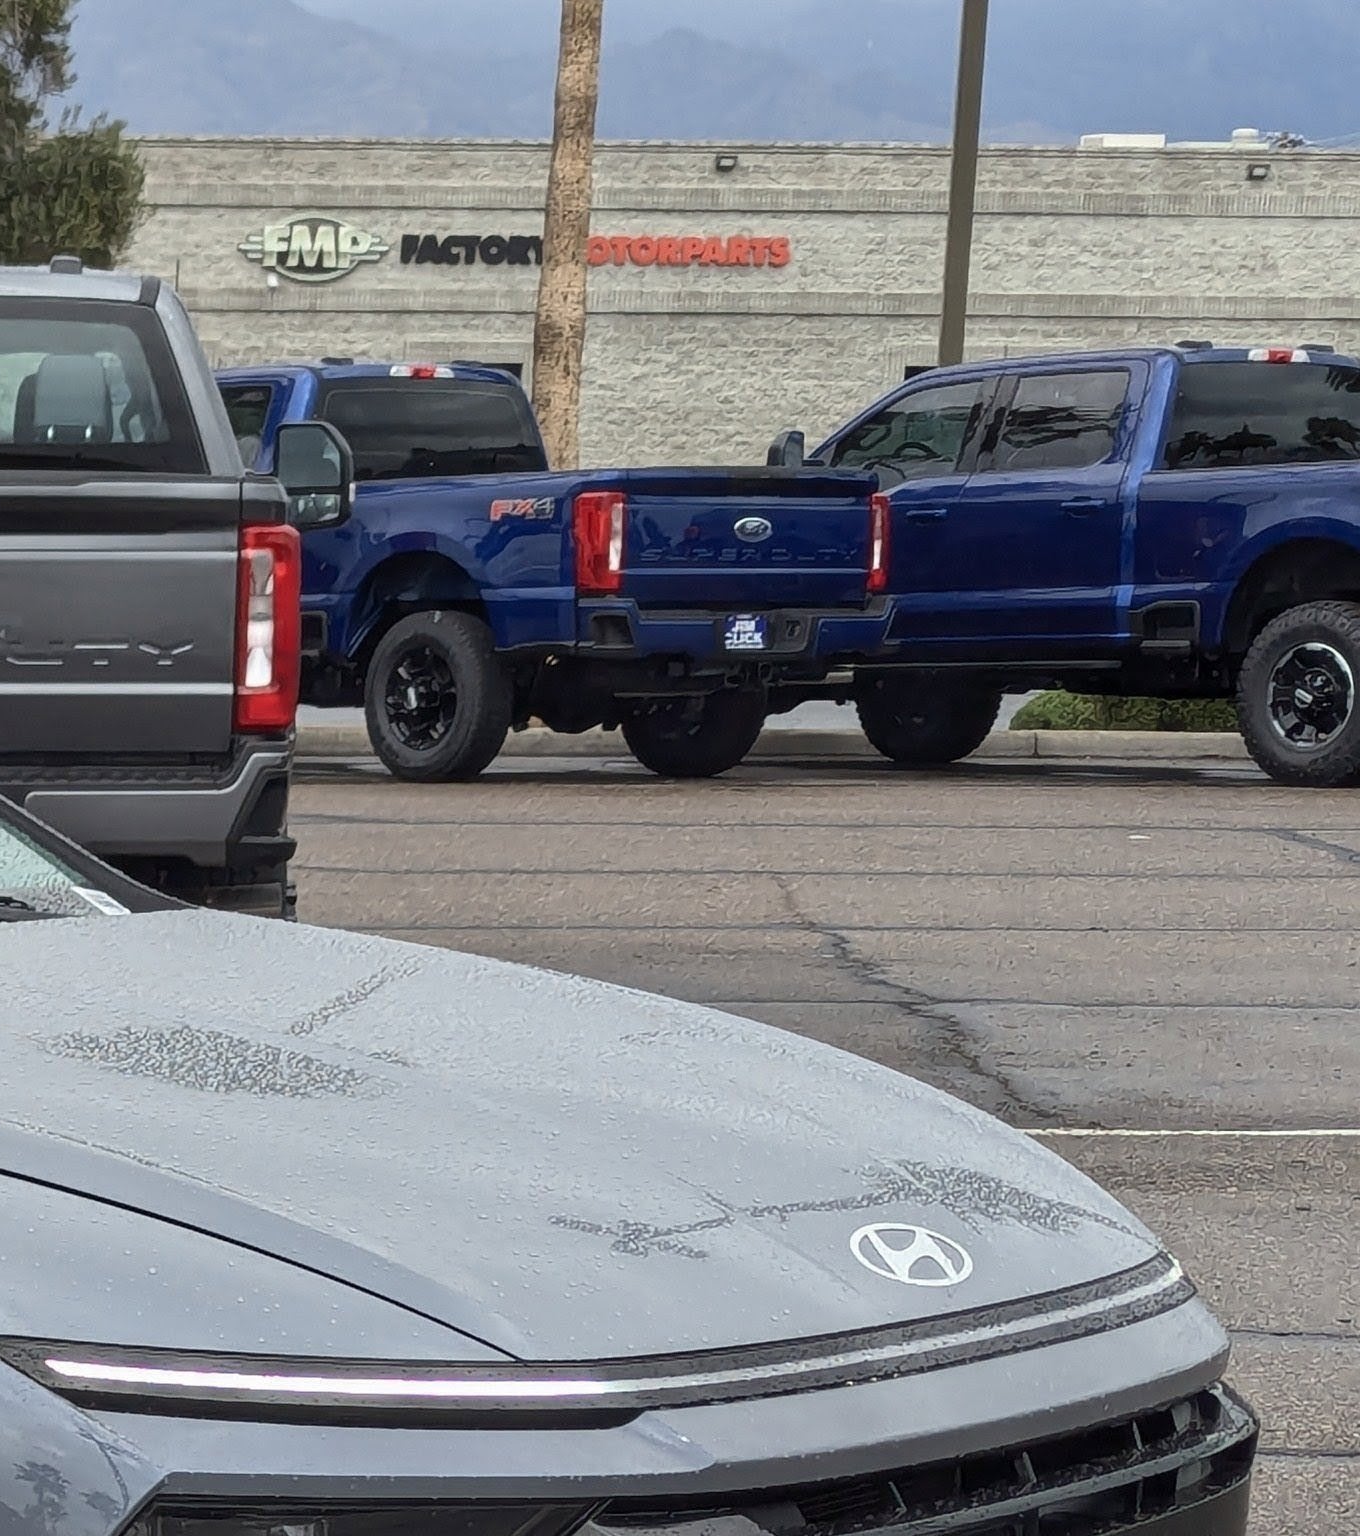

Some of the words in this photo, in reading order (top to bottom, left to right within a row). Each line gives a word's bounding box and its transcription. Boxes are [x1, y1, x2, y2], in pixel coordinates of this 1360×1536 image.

[261, 225, 373, 269] FMP
[586, 235, 791, 267] OTORPARTS
[489, 496, 555, 522] FX4
